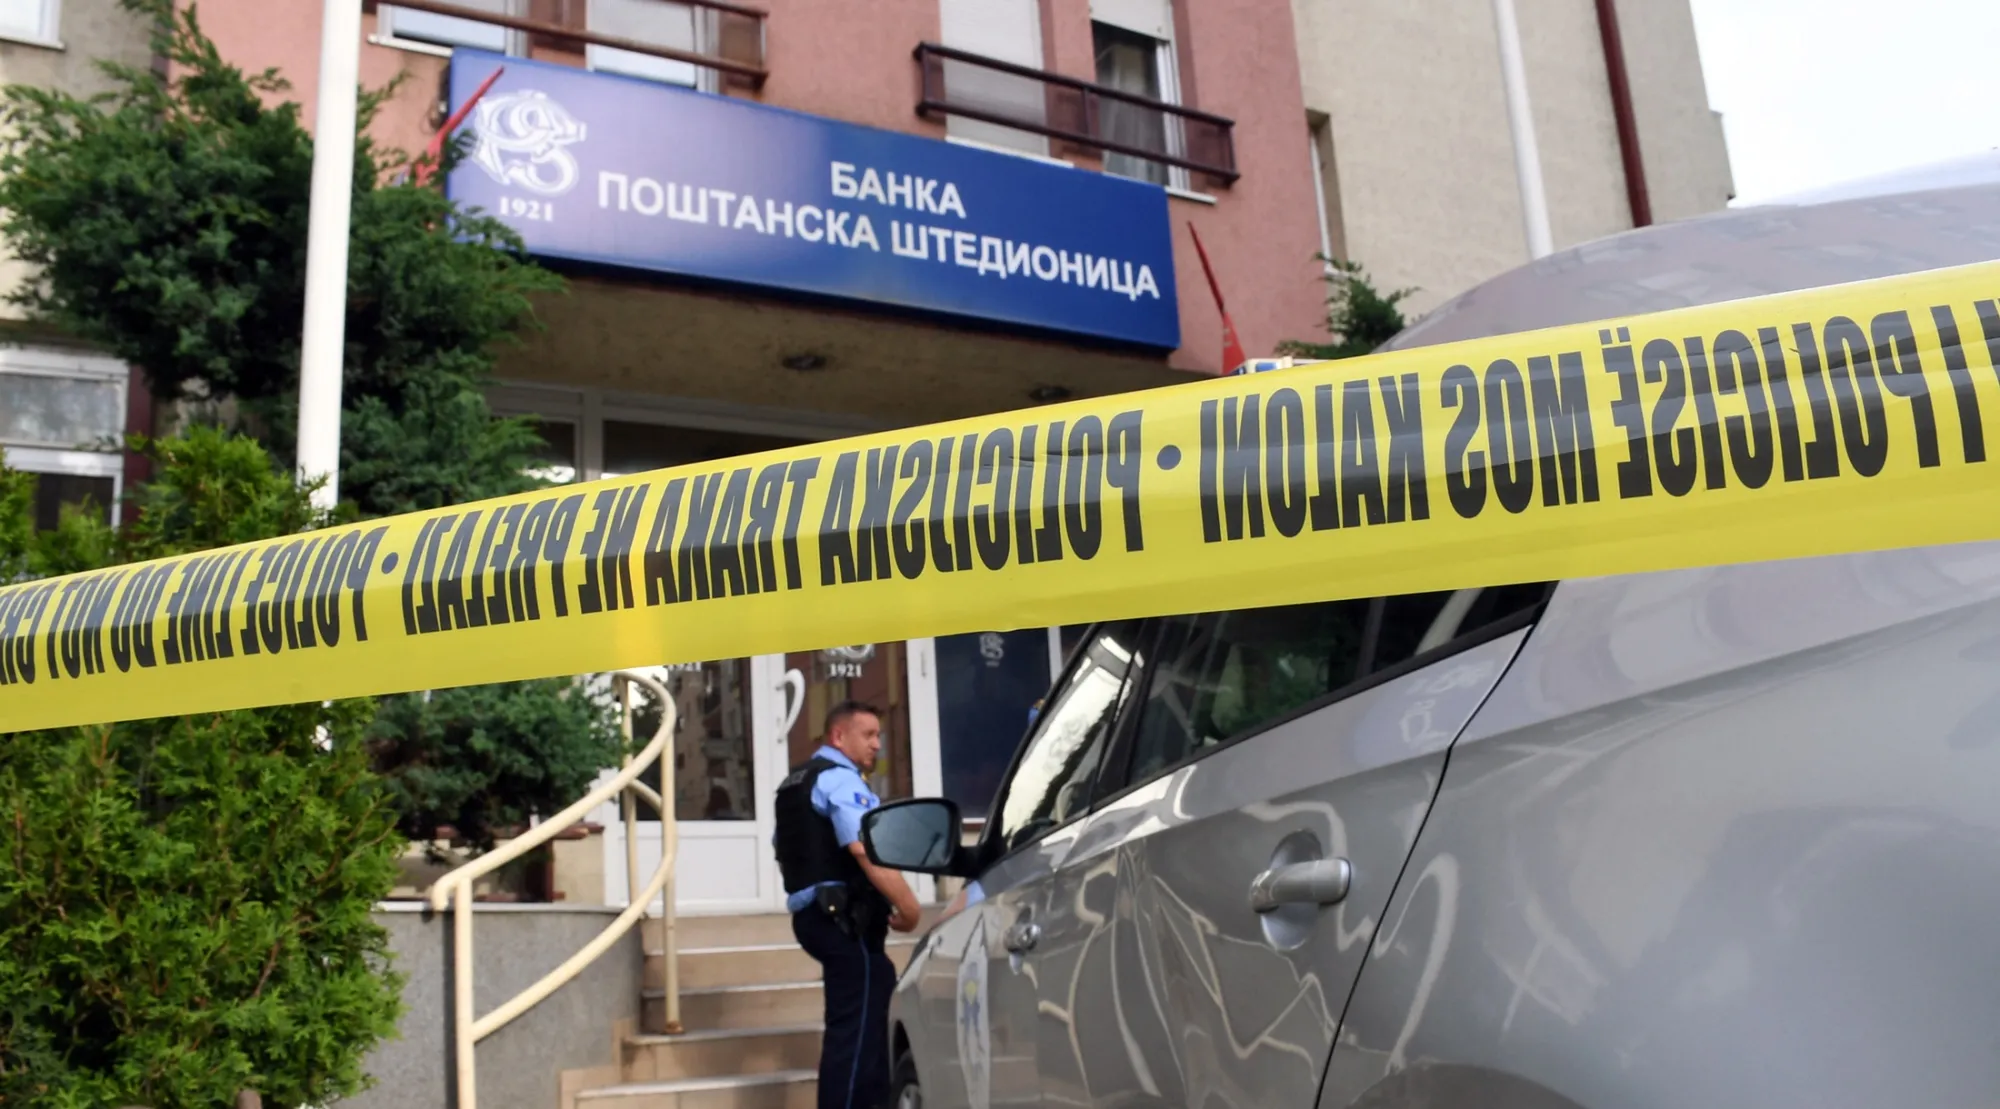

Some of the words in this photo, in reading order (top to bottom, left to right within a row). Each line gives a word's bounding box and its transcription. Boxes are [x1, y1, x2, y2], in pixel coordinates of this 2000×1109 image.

[501, 196, 553, 221] 1921
[830, 161, 967, 219] БАНКА
[598, 171, 880, 253] ПОШТАНСКА
[890, 221, 1160, 301] ШТЕДИОНИЦА
[830, 663, 862, 678] 1921
